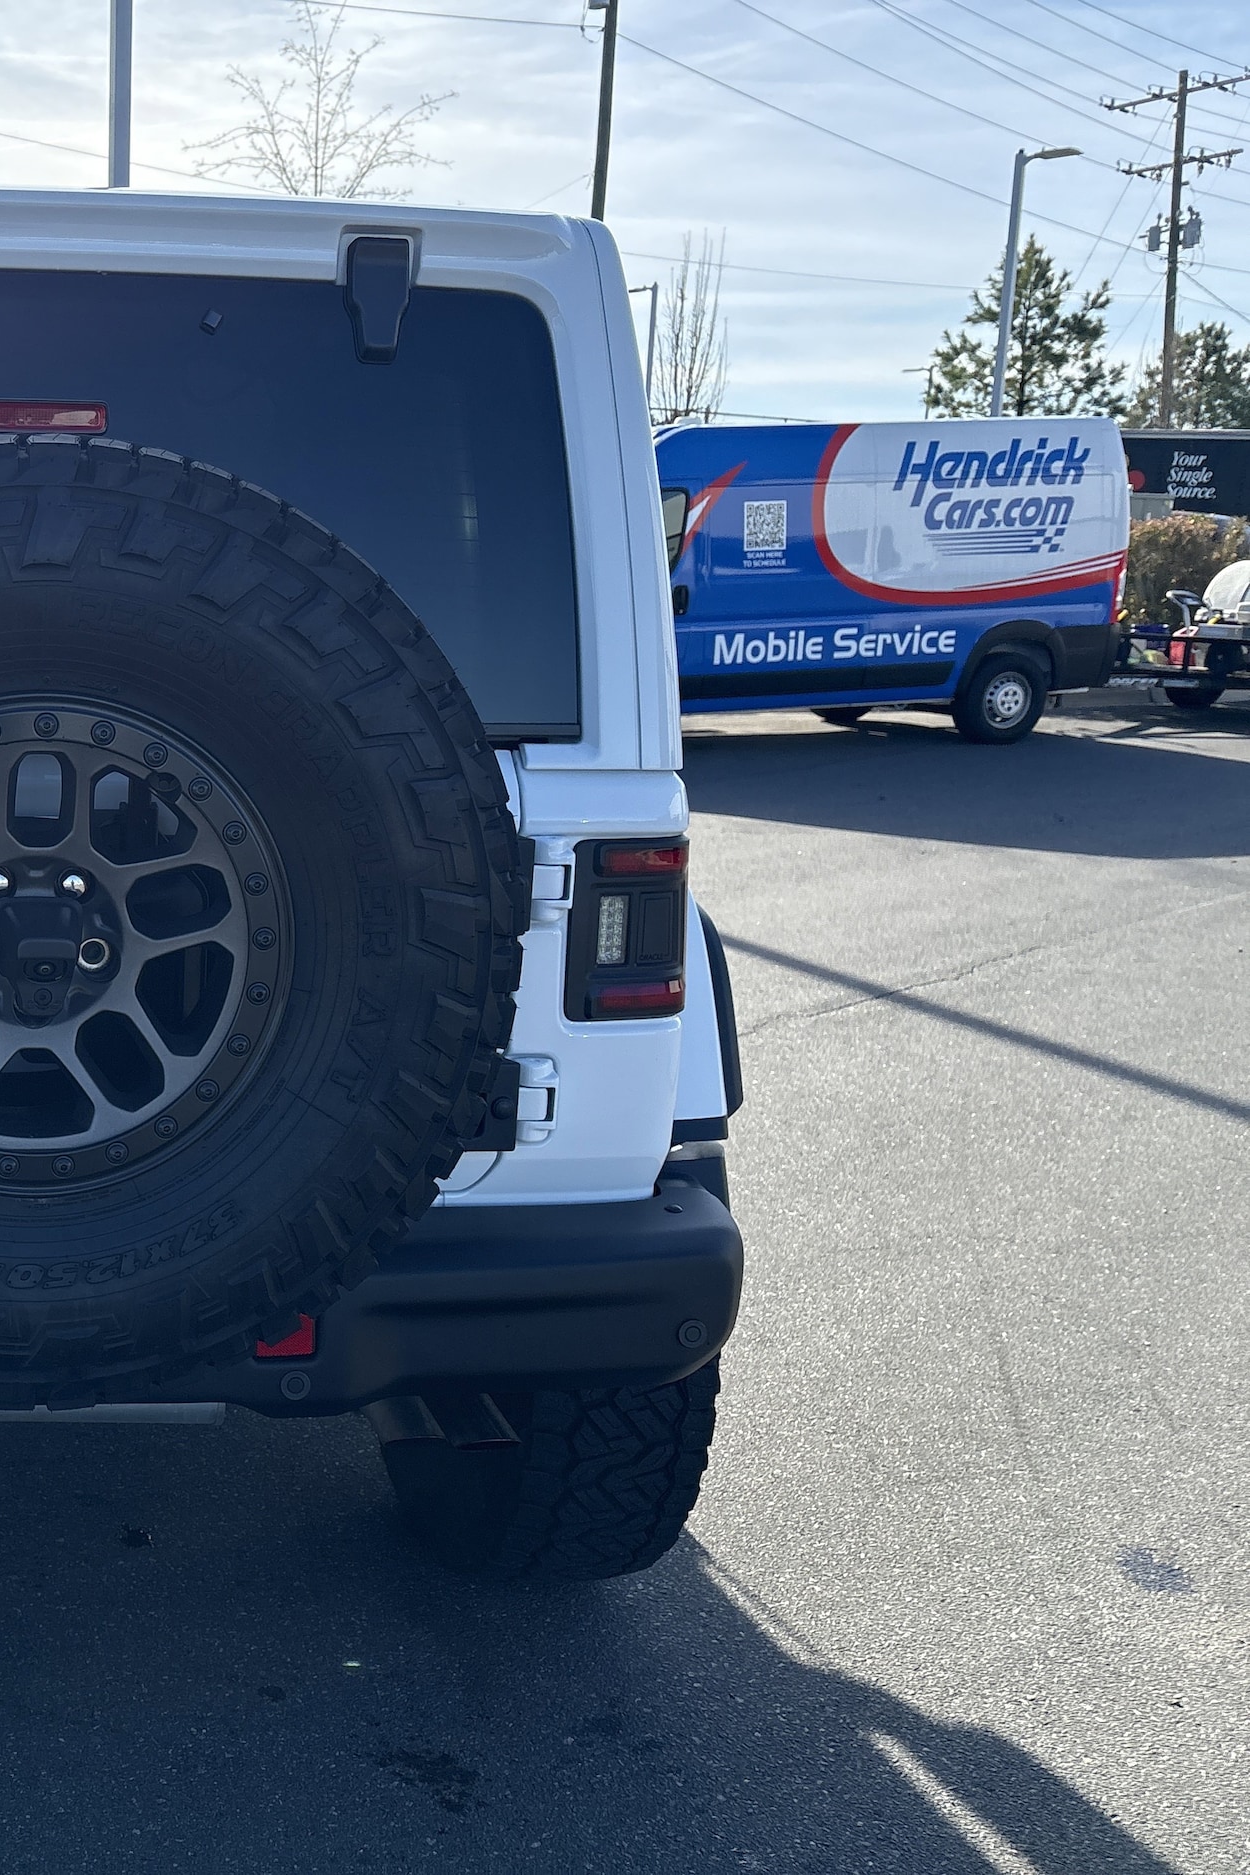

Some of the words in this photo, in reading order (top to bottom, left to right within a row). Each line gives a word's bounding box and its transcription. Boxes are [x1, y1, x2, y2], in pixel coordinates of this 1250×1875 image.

[1172, 451, 1207, 466] Your
[893, 437, 1091, 507] Hendrick
[1167, 467, 1213, 486] Single
[1167, 483, 1216, 499] Source.
[924, 492, 1074, 530] Cars.com
[743, 559, 752, 568] TO
[753, 558, 786, 567] SCHEDULE
[746, 551, 764, 559] SCAN
[765, 551, 783, 559] HERE
[713, 629, 823, 665] Mobile
[833, 624, 956, 659] Service
